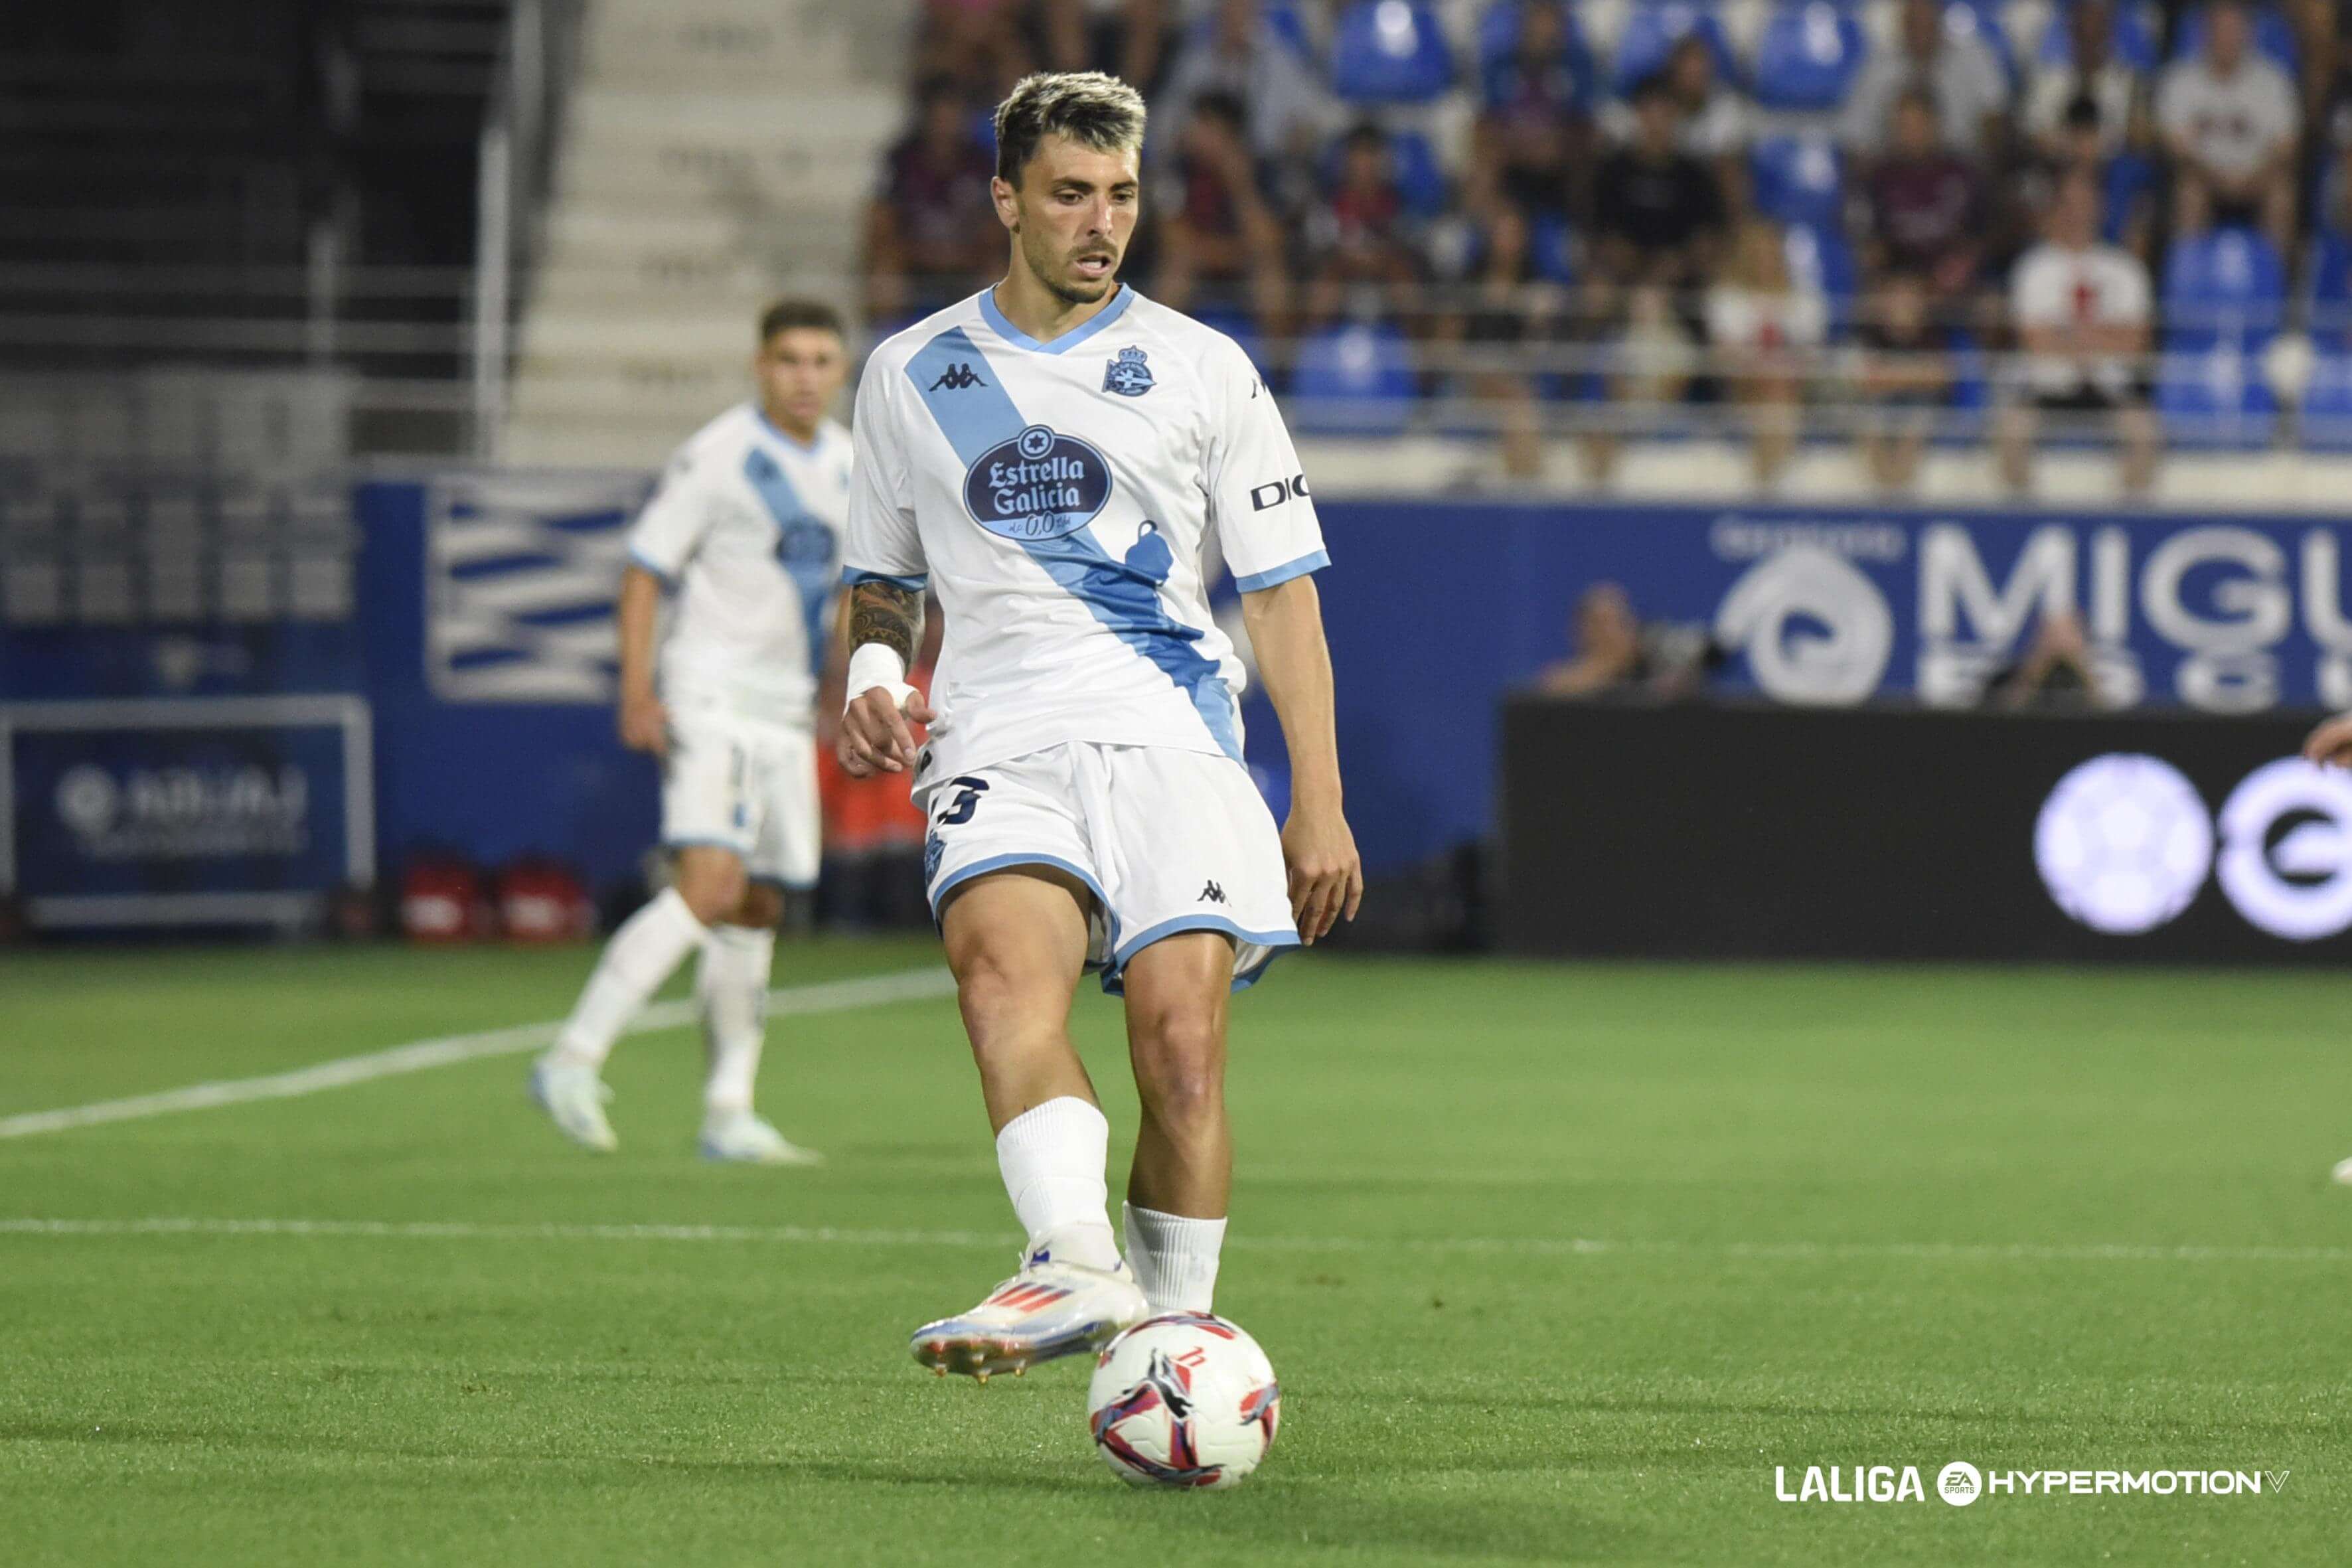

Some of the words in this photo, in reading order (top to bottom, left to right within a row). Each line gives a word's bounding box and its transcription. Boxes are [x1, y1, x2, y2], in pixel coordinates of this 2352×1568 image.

[988, 456, 1085, 489] Estrella
[994, 482, 1081, 514] Galicia
[931, 775, 990, 824] 3
